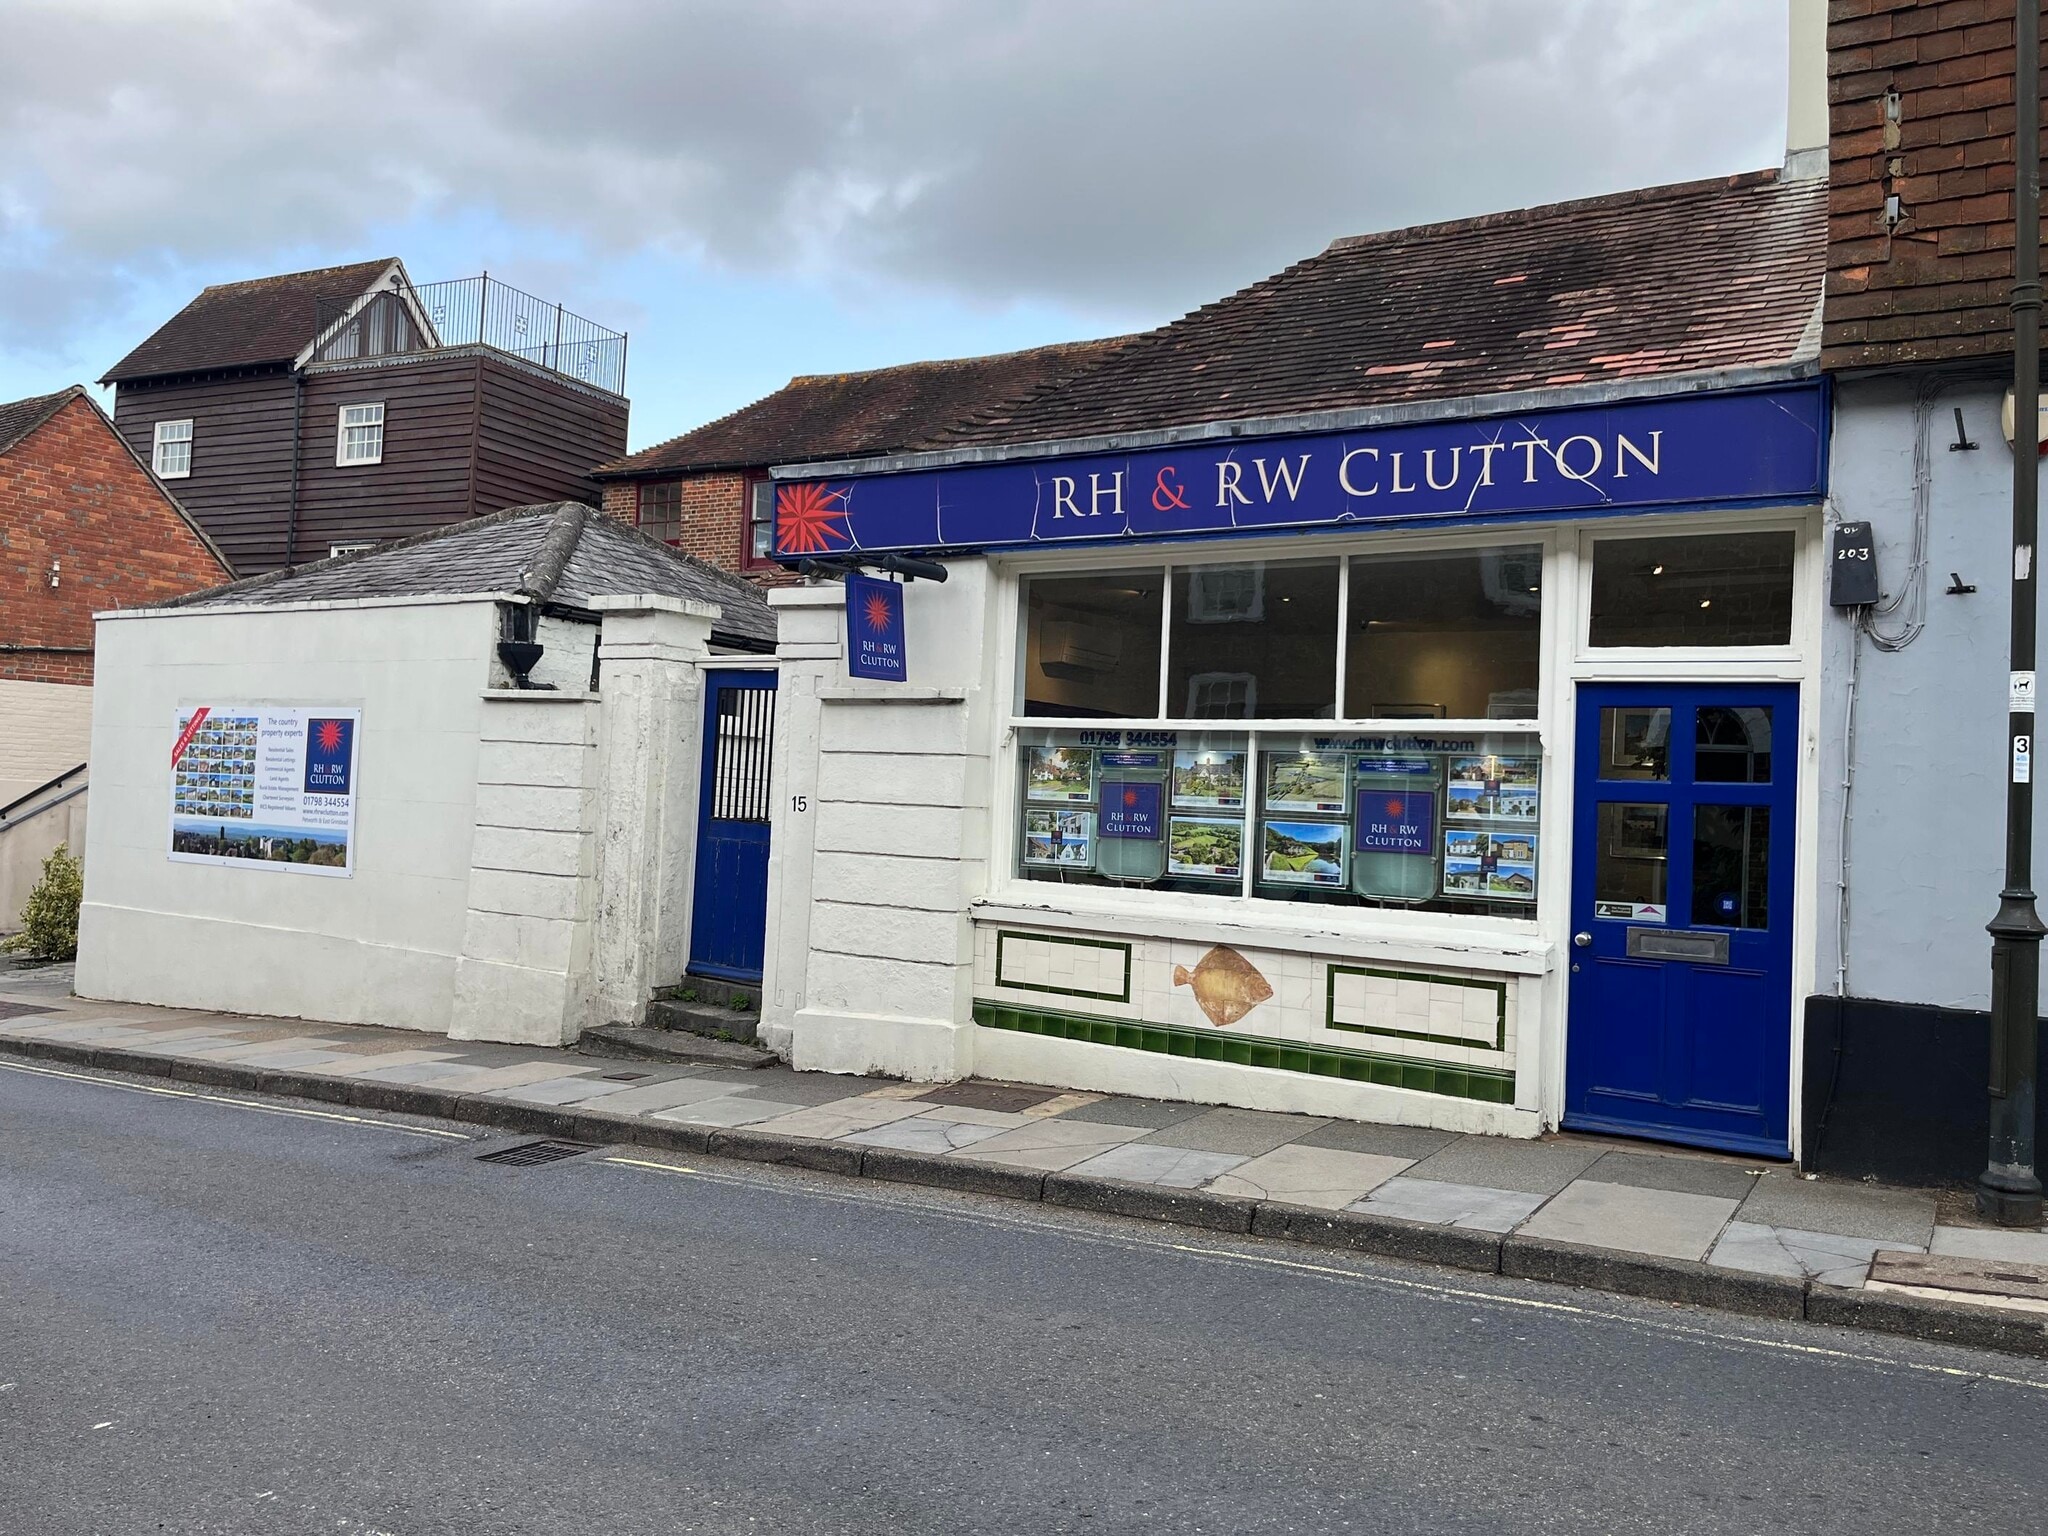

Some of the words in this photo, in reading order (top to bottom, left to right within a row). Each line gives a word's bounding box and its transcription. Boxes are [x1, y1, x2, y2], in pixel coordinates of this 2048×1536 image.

[1052, 471, 1126, 519] RH
[1152, 466, 1192, 512] &
[1214, 454, 1313, 508] RW
[1338, 430, 1664, 497] CLUTTON
[1838, 547, 1869, 561] 203
[863, 640, 876, 652] RH
[883, 642, 897, 654] RW
[860, 654, 900, 668] CLUTTON
[268, 717, 278, 726] The
[279, 718, 298, 728] country
[261, 730, 283, 739] property
[284, 730, 303, 739] experts
[2016, 737, 2028, 754] 3
[313, 763, 324, 774] RH
[331, 764, 344, 774] RW
[310, 774, 345, 785] CLUTTON
[303, 796, 323, 806] 01798
[324, 797, 349, 808] 344554
[791, 795, 807, 813] 15
[1111, 812, 1124, 821] RH
[1133, 812, 1149, 822] RW
[1106, 822, 1151, 833] CLUTTON
[1371, 823, 1387, 834] RH
[1399, 824, 1418, 835] RW
[1365, 835, 1422, 848] CLUTTON
